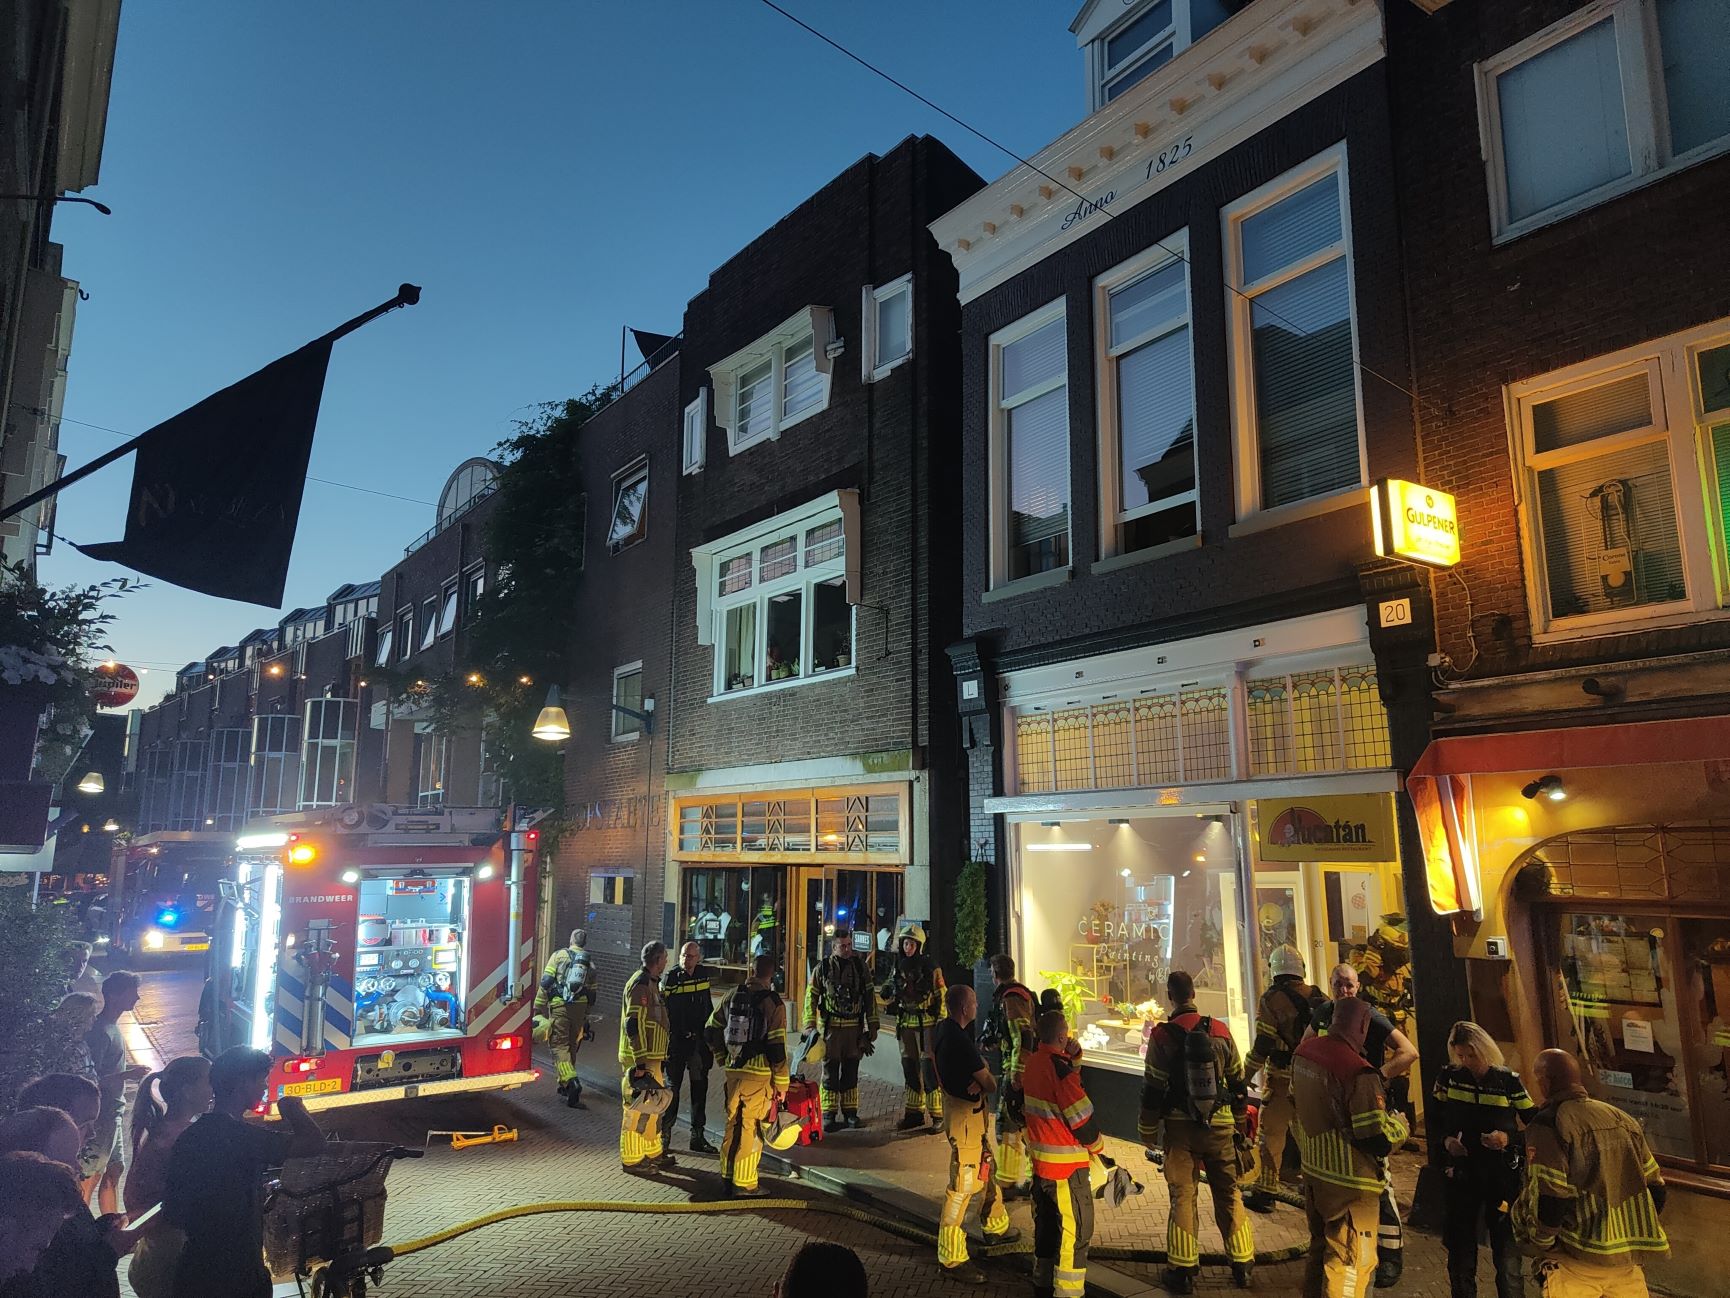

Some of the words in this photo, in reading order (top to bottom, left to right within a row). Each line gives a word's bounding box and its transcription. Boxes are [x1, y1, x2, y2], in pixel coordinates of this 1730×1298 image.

[1061, 189, 1117, 230] Anno
[1145, 135, 1193, 180] 1825
[1406, 507, 1456, 536] GULPENER
[1384, 603, 1406, 623] 20
[288, 894, 353, 904] BRANDWEER
[1078, 918, 1170, 940] CERAMIC
[1313, 939, 1324, 948] 20
[1096, 942, 1159, 969] Painting
[287, 1081, 337, 1094] 30-BLD-2
